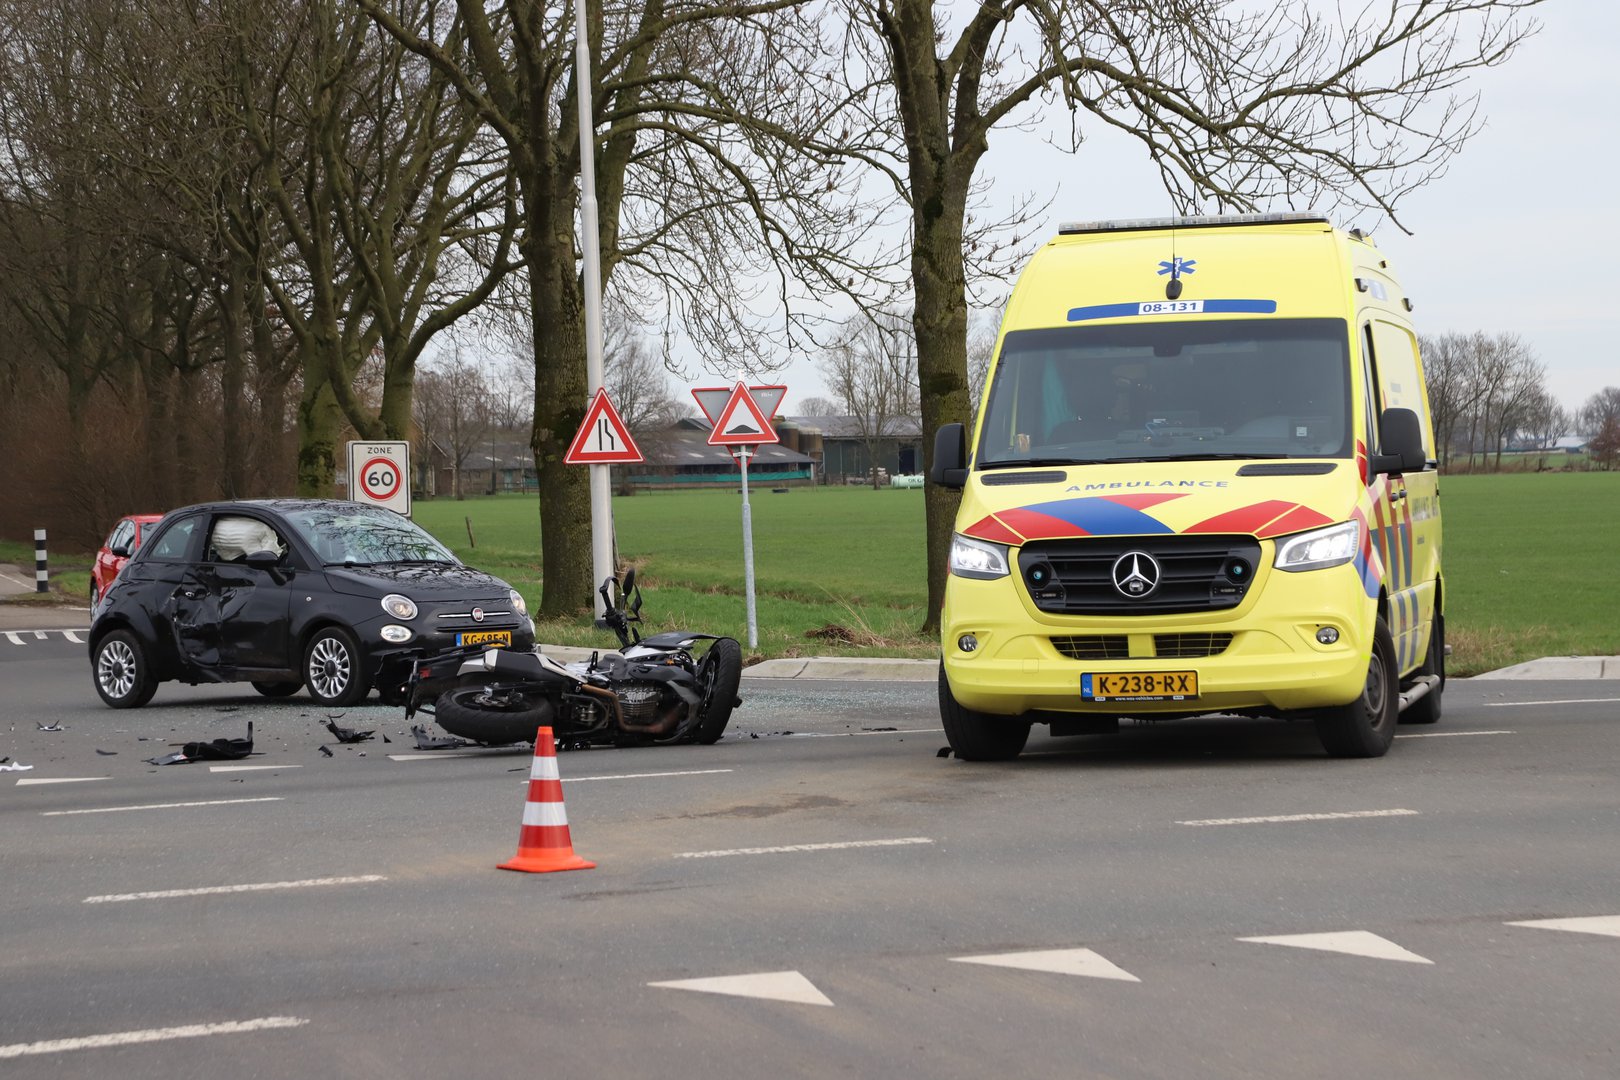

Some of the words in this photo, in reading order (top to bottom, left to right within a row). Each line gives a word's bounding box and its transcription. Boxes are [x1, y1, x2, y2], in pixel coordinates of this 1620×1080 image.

[1142, 302, 1197, 312] 08-131
[367, 446, 393, 454] ZONE
[368, 471, 393, 487] 60
[1065, 480, 1229, 492] AMBULANCE
[1099, 675, 1189, 694] K-238-RX
